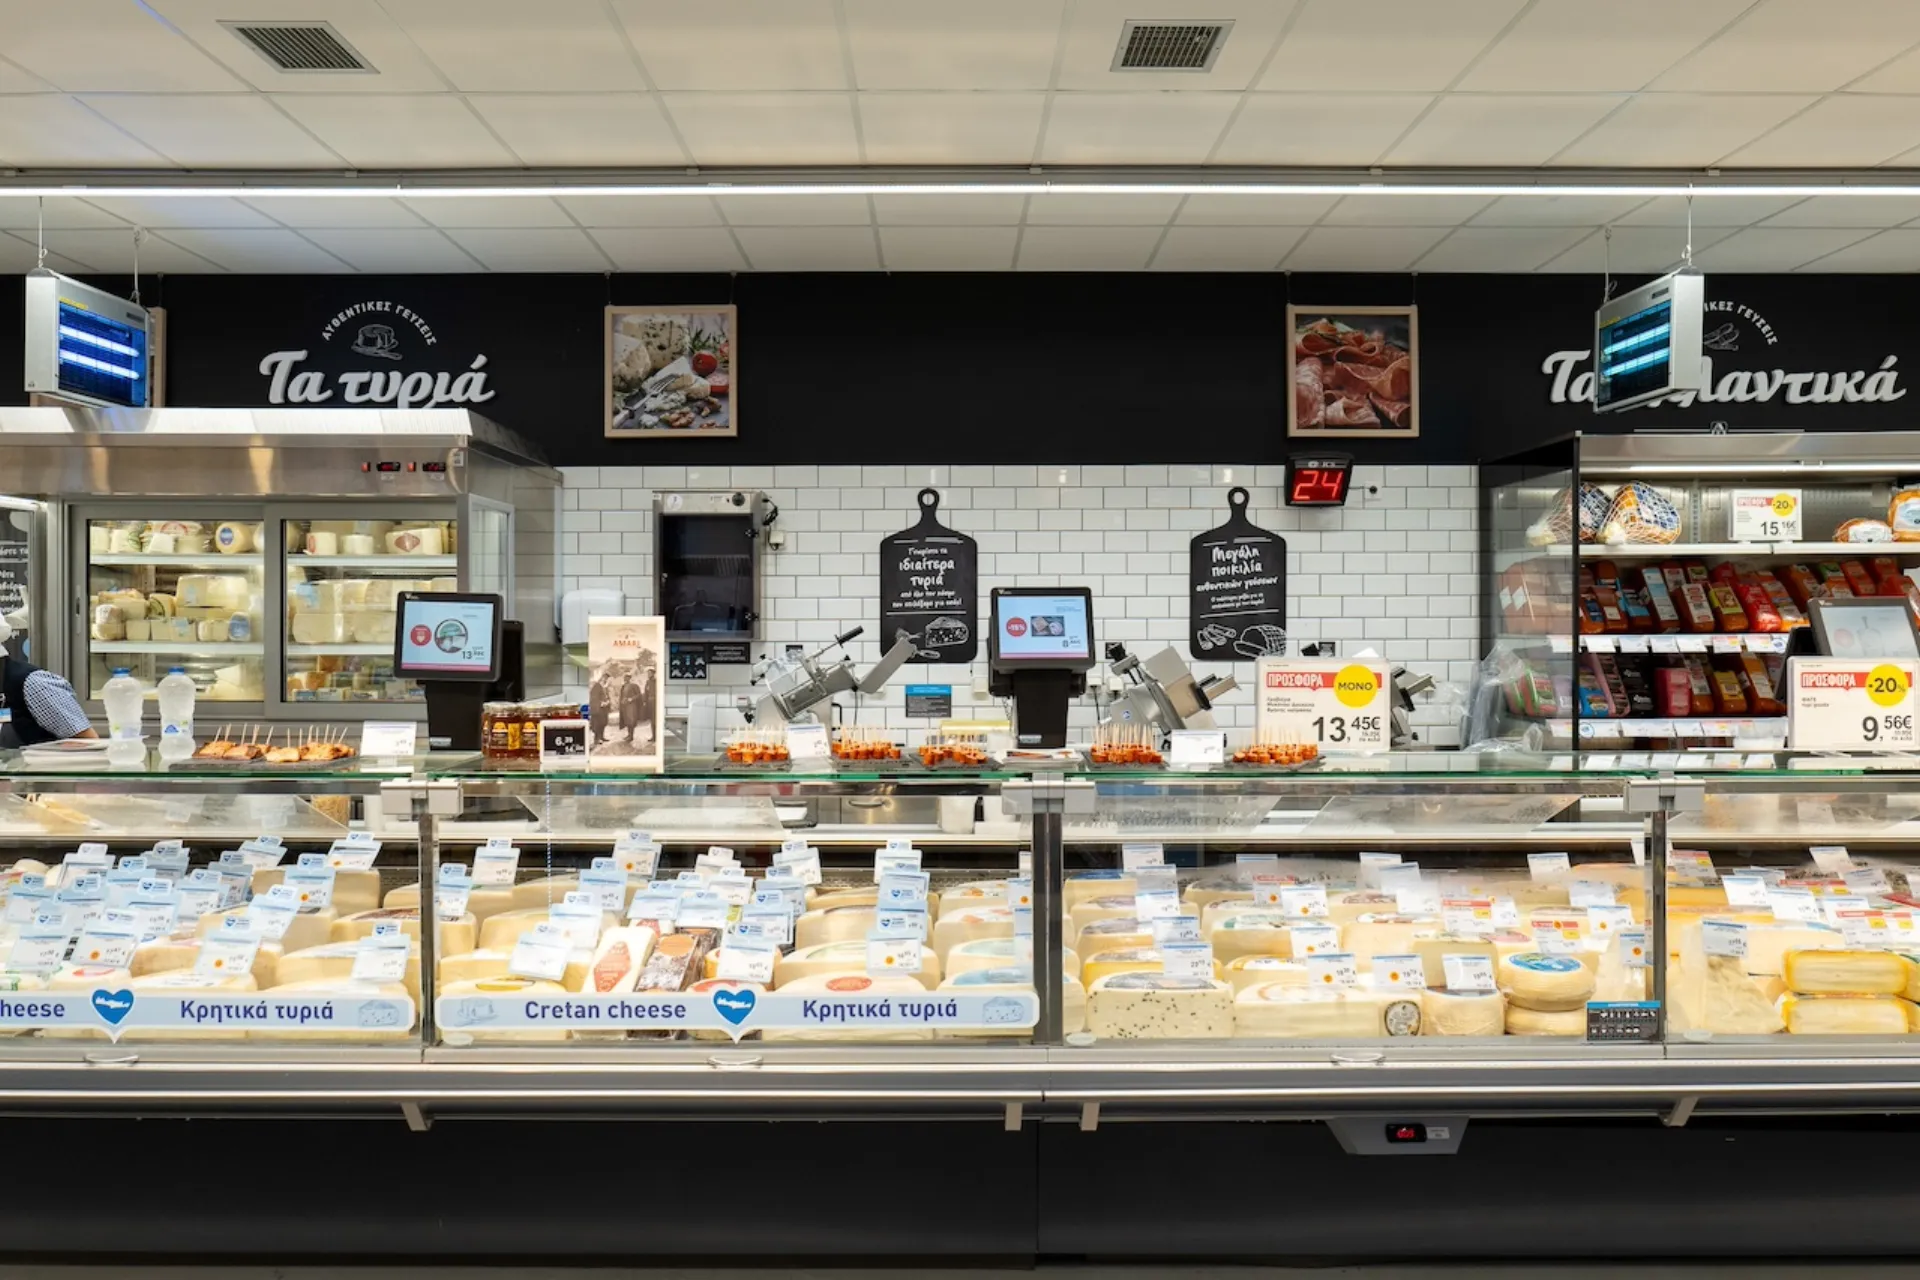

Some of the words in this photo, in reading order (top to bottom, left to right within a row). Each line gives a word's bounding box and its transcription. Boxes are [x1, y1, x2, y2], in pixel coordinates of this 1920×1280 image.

[322, 300, 392, 341] ΑΥΘΕΝΤΙΚΕΣ
[395, 304, 437, 346] ΓΕΥΣΕΙΣ
[1737, 304, 1778, 345] ΓΕΥΣΕΙΣ
[259, 349, 333, 404] Τα
[338, 354, 496, 409] τυριά
[1293, 470, 1343, 500] 24
[1212, 545, 1260, 564] Μεγάλη
[899, 557, 955, 574] ιδιαίτερα
[1211, 559, 1263, 577] ποικιλία
[910, 574, 944, 590] τυριά
[1267, 672, 1324, 687] ΠΡΟΣΦΟΡΑ
[1338, 682, 1373, 691] ΜΟΝΟ
[1801, 673, 1857, 687] ΠΡΟΣΦΟΡΑ
[1868, 677, 1906, 693] -20%
[0, 1000, 65, 1017] heese
[180, 1000, 267, 1022] Κρητικά
[275, 1001, 333, 1023] τυριά
[525, 1001, 600, 1019] Cretan
[607, 1001, 686, 1019] cheese
[803, 998, 891, 1022] Κρητικά
[898, 999, 957, 1022] τυριά
